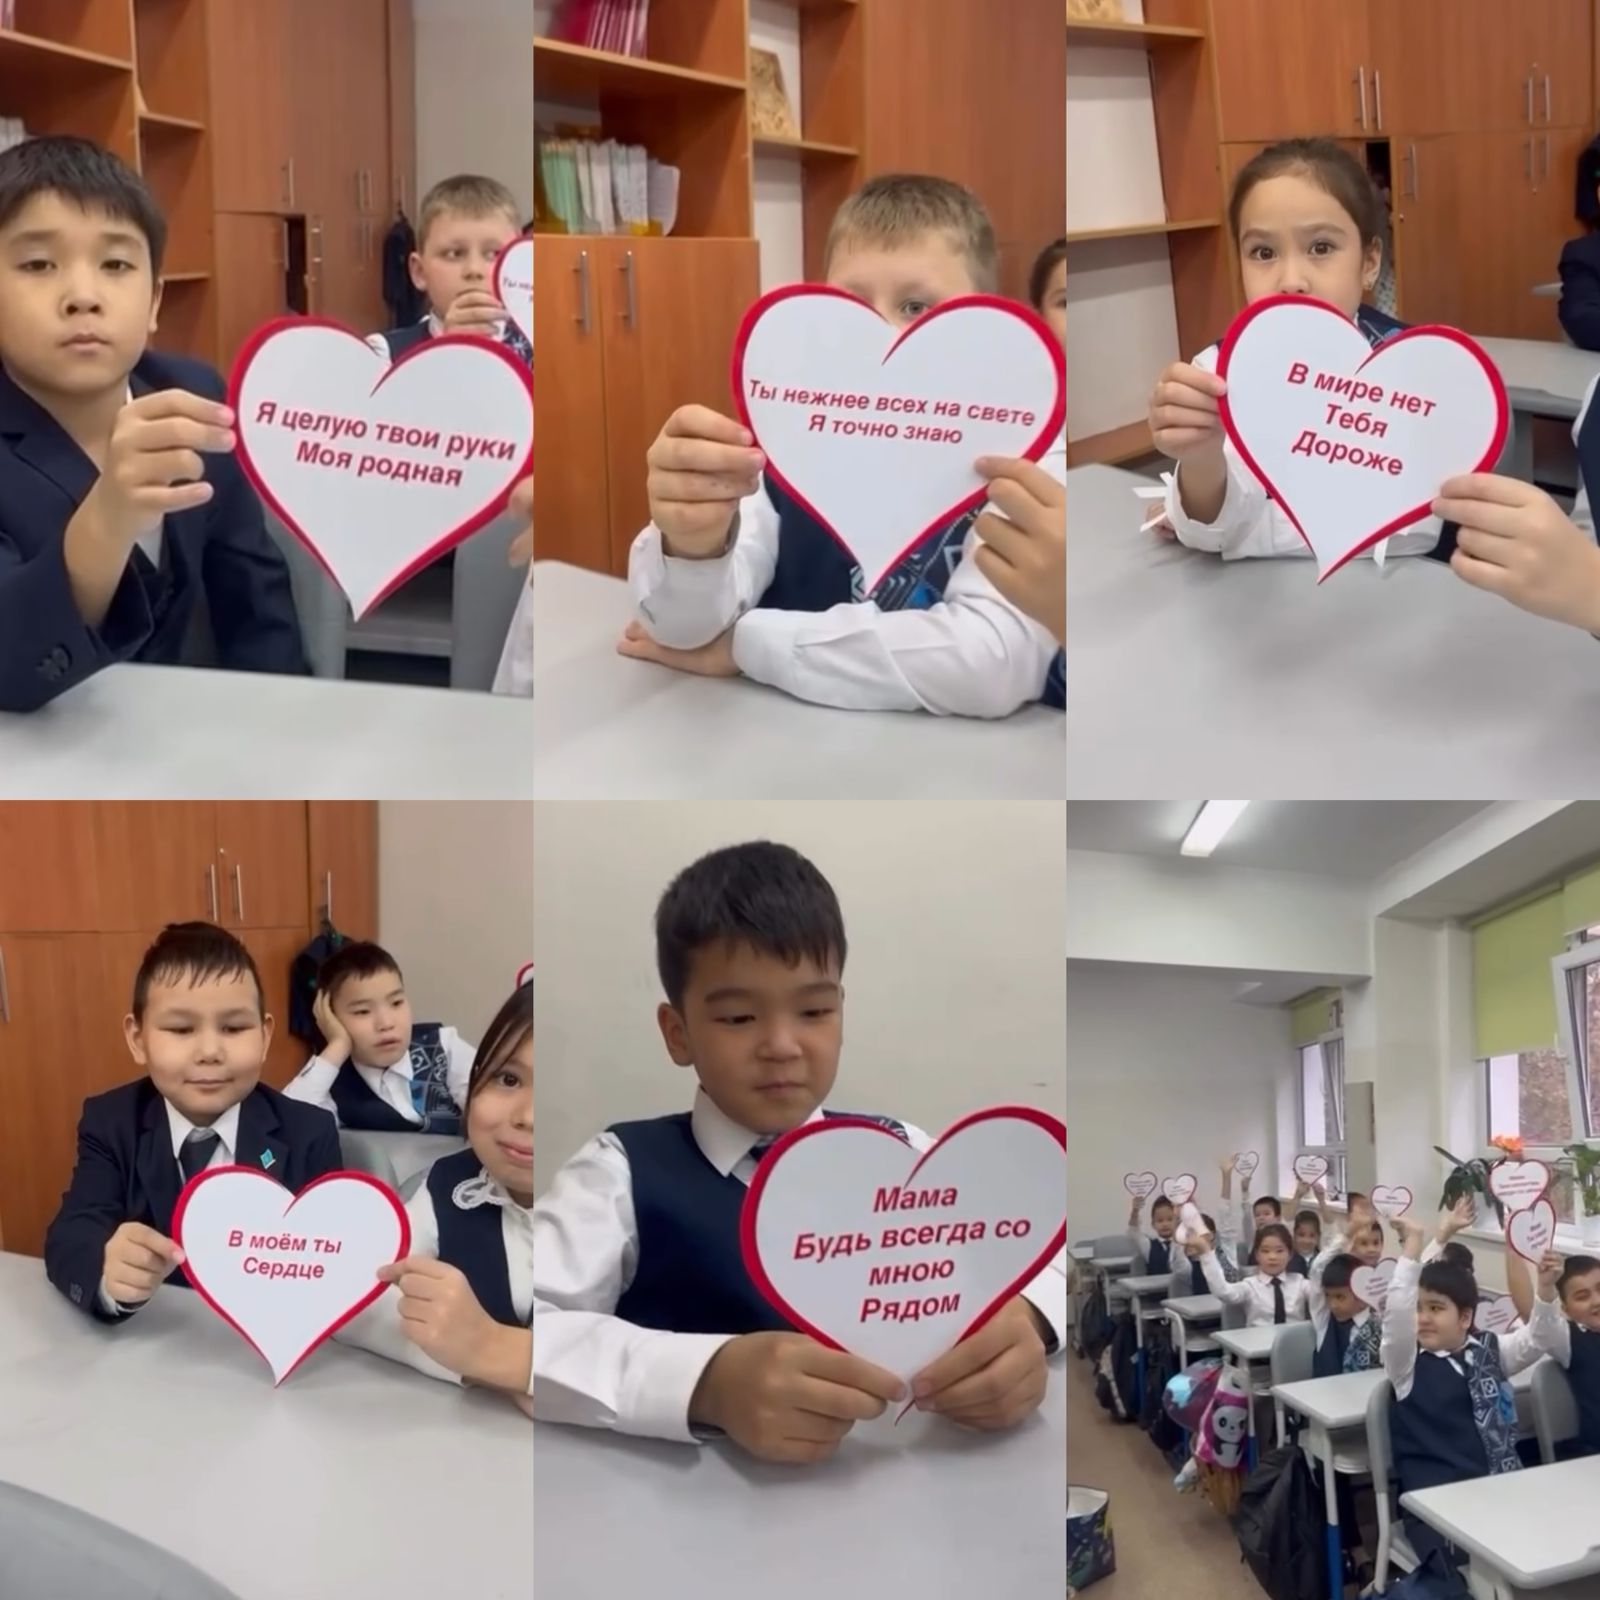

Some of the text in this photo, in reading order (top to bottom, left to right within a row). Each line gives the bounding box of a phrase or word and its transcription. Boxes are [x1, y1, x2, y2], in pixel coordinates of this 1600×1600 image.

[749, 379, 1036, 426] Ты нежнее всех на свете
[1287, 362, 1437, 417] В мире нет
[255, 402, 516, 461] Я целую твои руки
[808, 414, 963, 444] Я точно знаю
[1325, 403, 1388, 438] Тебя
[296, 440, 463, 487] Моя родная
[1291, 430, 1404, 476] Дороже
[873, 1186, 958, 1213] Мама
[228, 1230, 342, 1254] В моём ты
[794, 1218, 1031, 1263] Будь всегда со
[243, 1256, 325, 1279] Сердце
[869, 1260, 955, 1286] мною
[860, 1293, 961, 1323] Рядом
